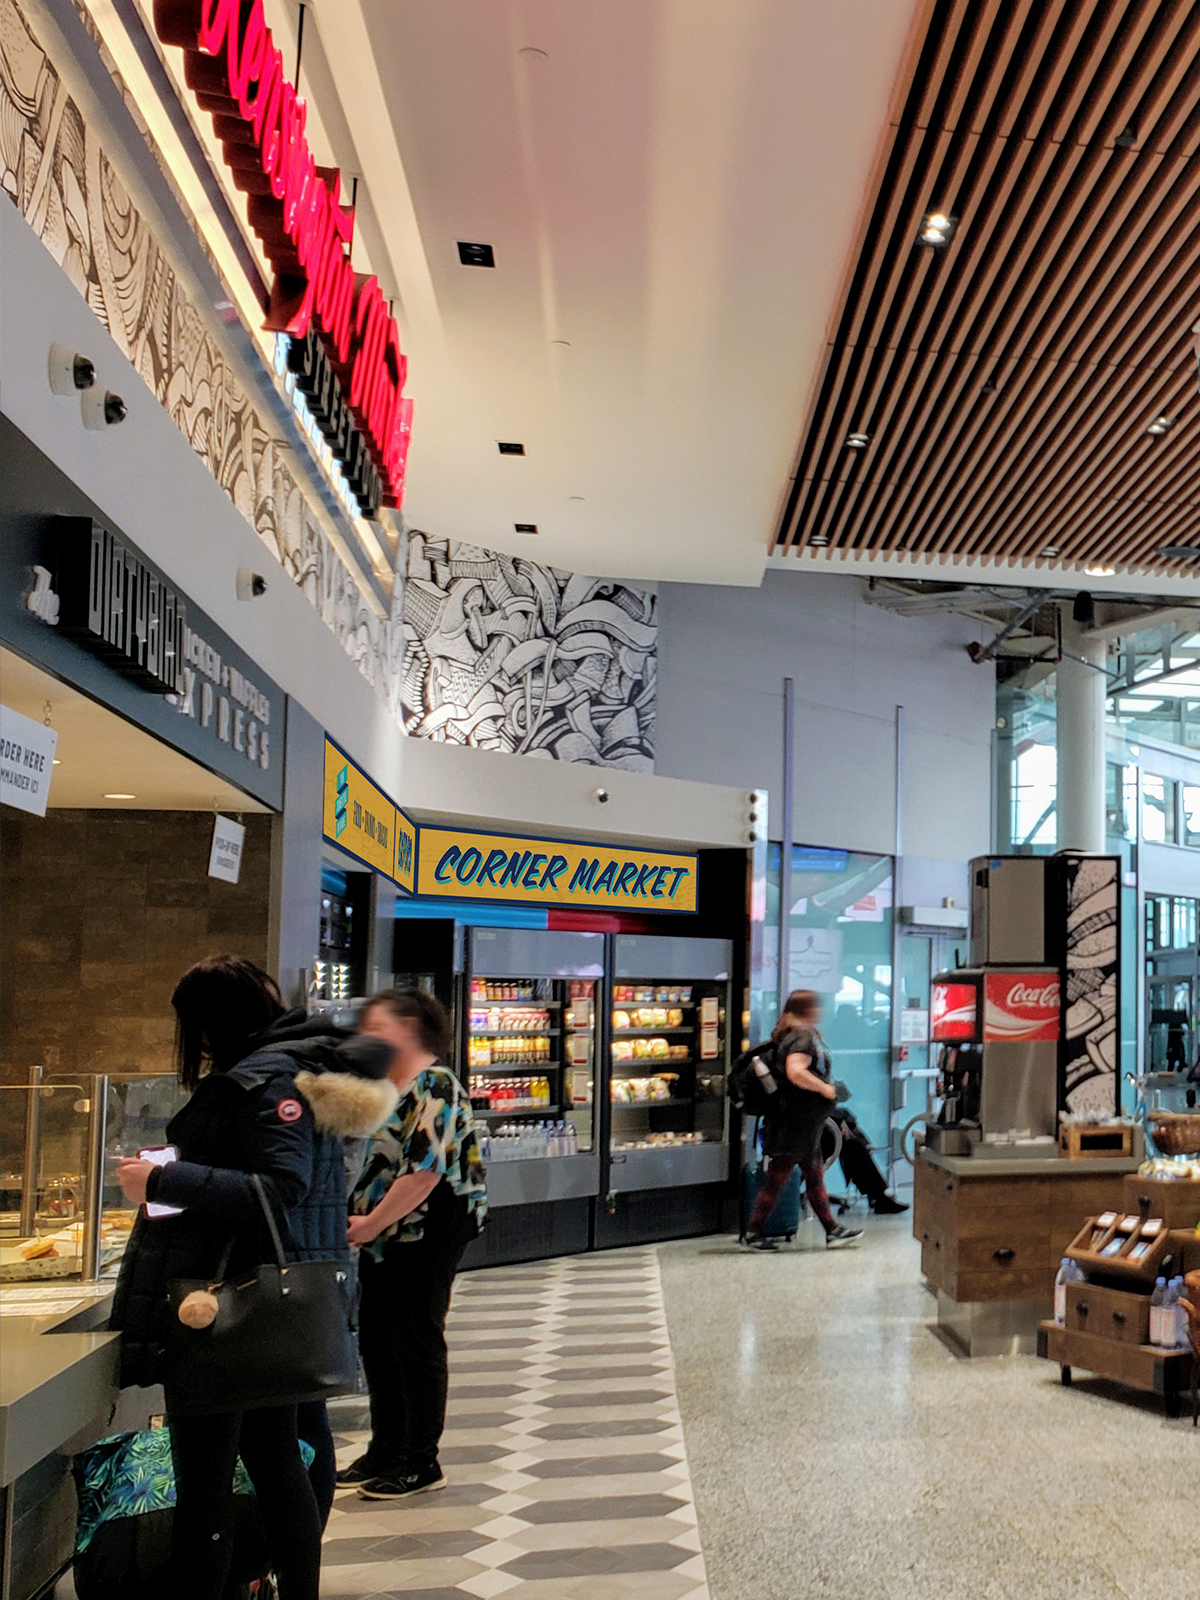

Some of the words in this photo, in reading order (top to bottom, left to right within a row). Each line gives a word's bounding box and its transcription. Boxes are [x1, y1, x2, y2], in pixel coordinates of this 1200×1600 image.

[166, 667, 269, 770] XPRESS
[0, 737, 22, 764] RDER
[23, 748, 45, 772] HERE
[0, 768, 30, 791] MMANDER
[434, 844, 568, 892] CORNER
[567, 857, 691, 900] MARKET
